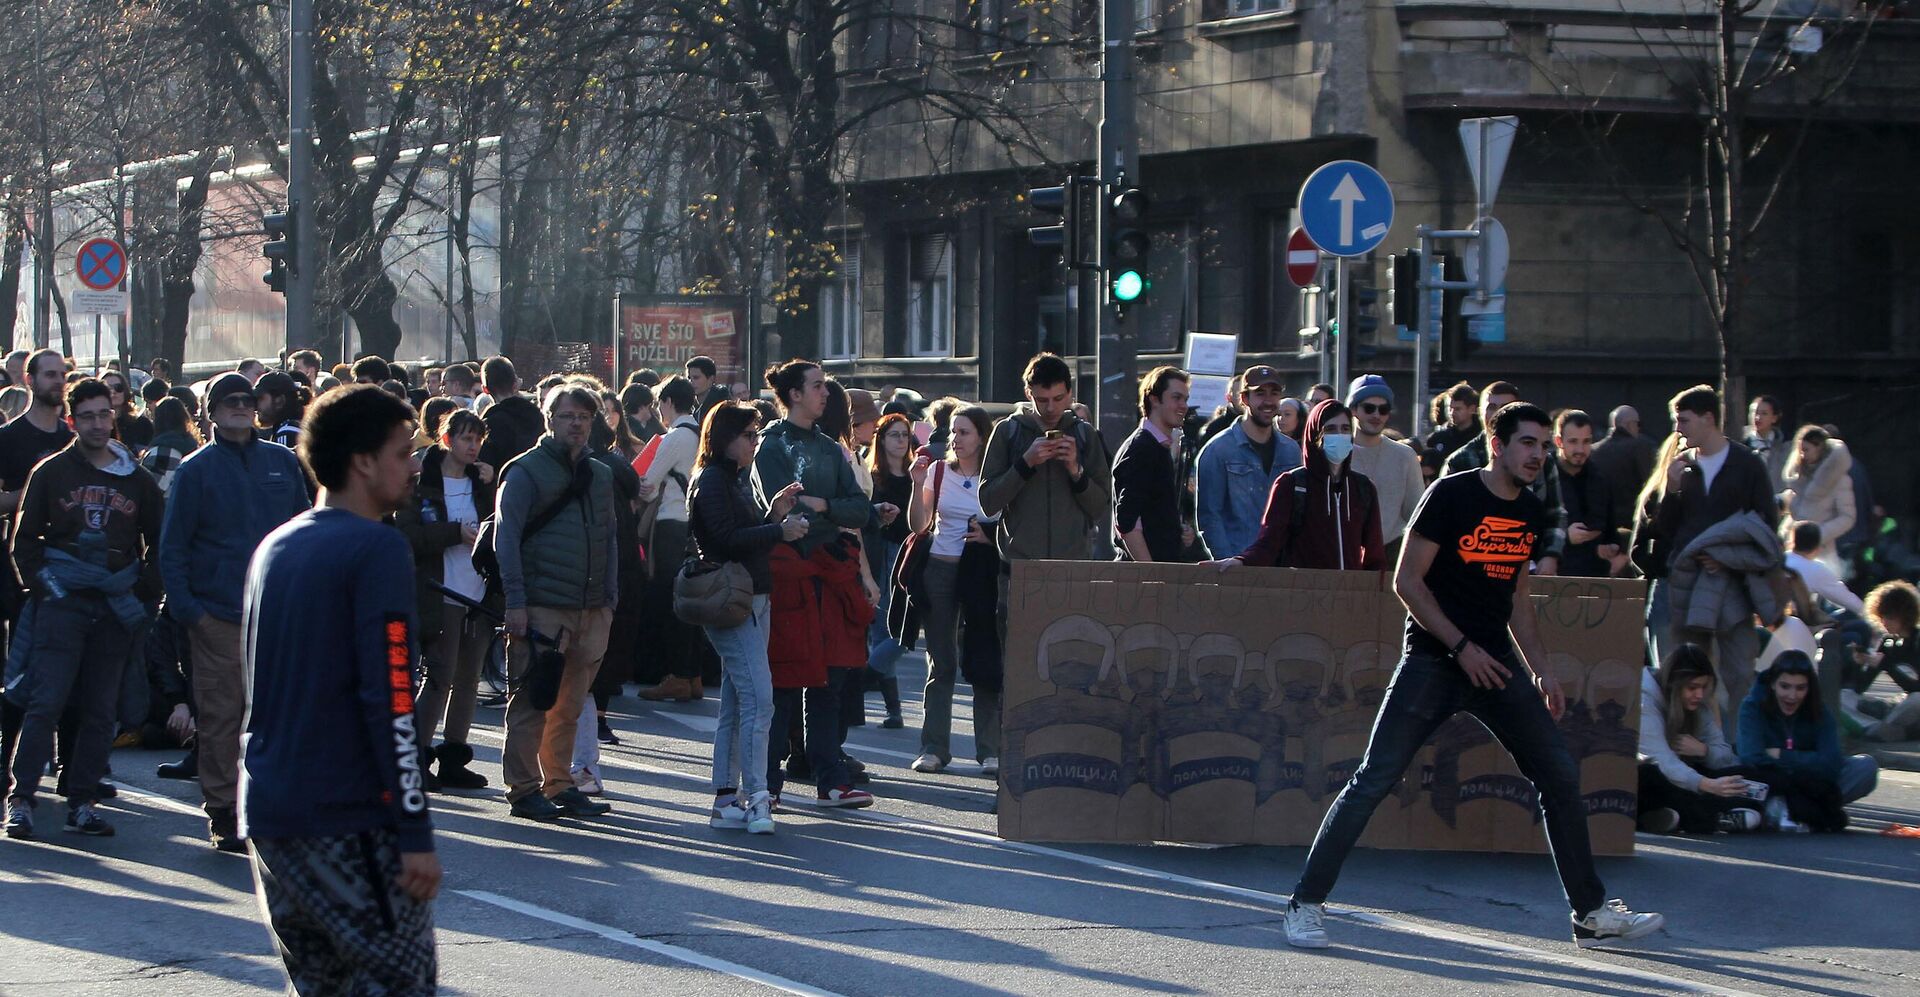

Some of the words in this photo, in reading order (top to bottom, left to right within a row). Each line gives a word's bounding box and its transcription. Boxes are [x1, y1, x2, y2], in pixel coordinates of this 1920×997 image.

[634, 323, 662, 340] SVE
[668, 319, 694, 340] ŠTO
[392, 713, 425, 813] OSAKA
[1027, 763, 1118, 783] ПОЛИЦИЈА
